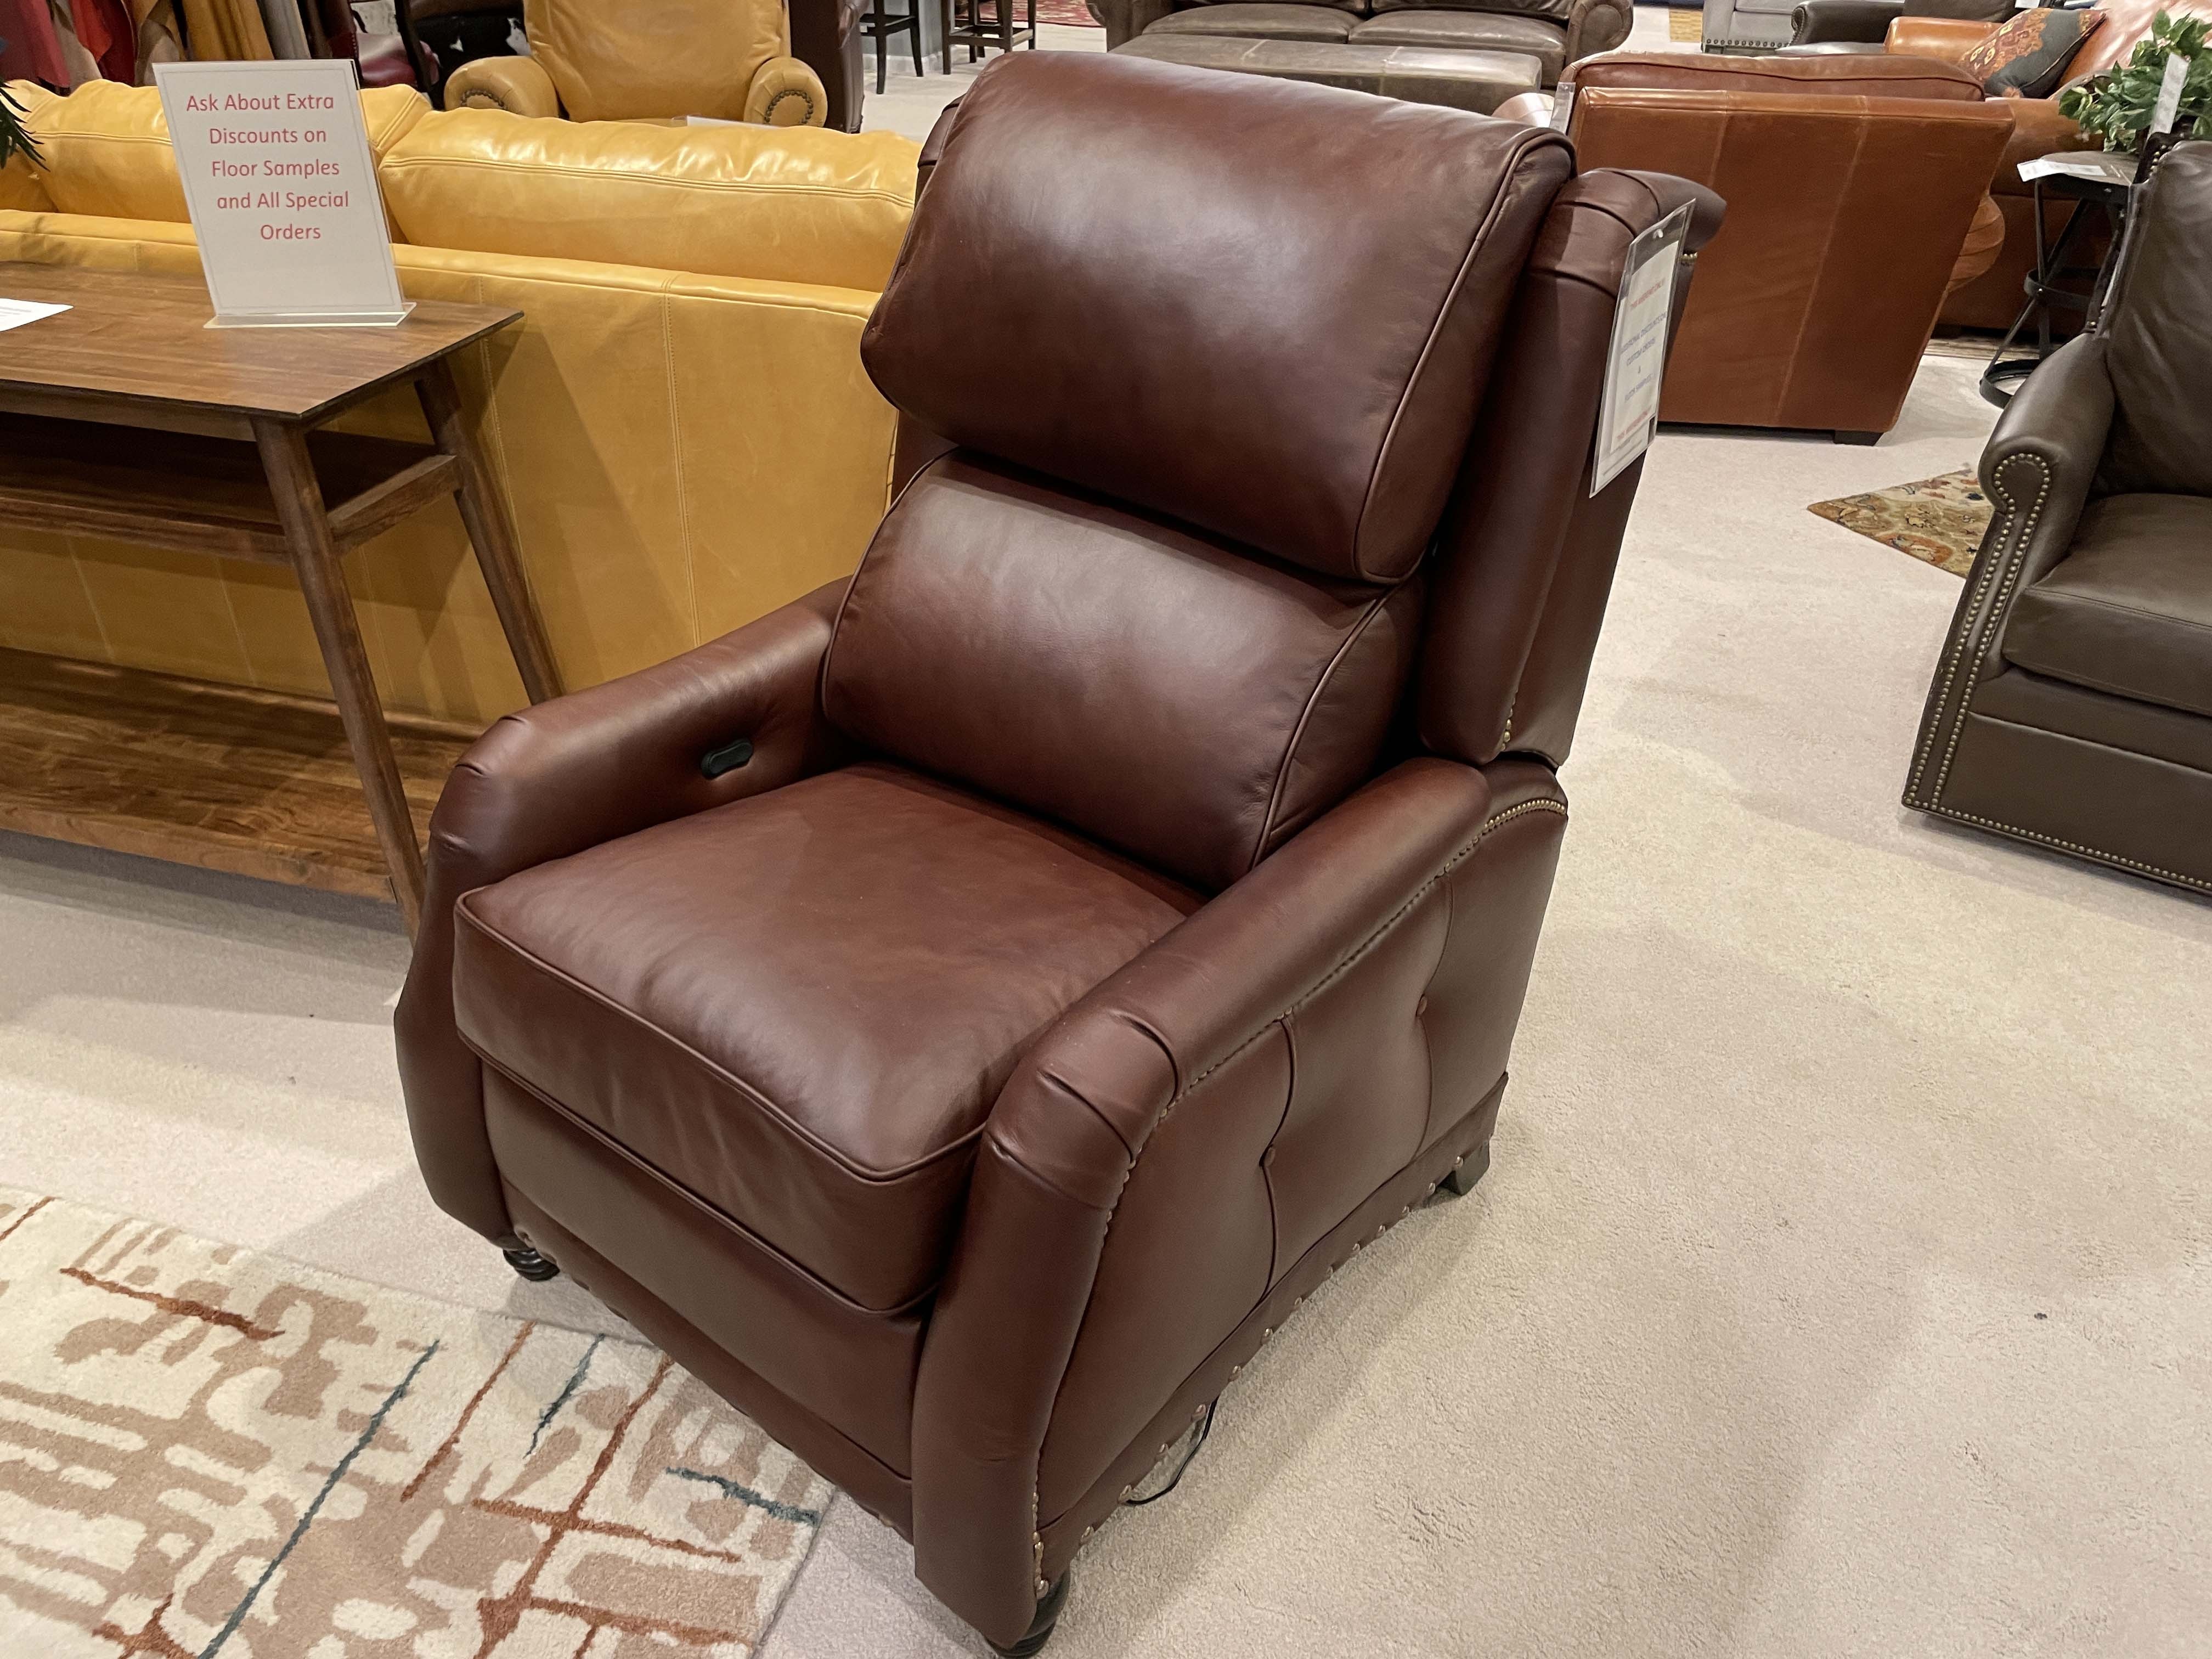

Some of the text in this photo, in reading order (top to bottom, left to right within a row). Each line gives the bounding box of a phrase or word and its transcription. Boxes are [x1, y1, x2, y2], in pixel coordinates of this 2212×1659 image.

[186, 93, 334, 111] Ask About Extra
[210, 128, 326, 144] Discounts on
[212, 159, 340, 179] Floor Samples
[217, 191, 349, 211] and All Special
[260, 223, 321, 240] Orders
